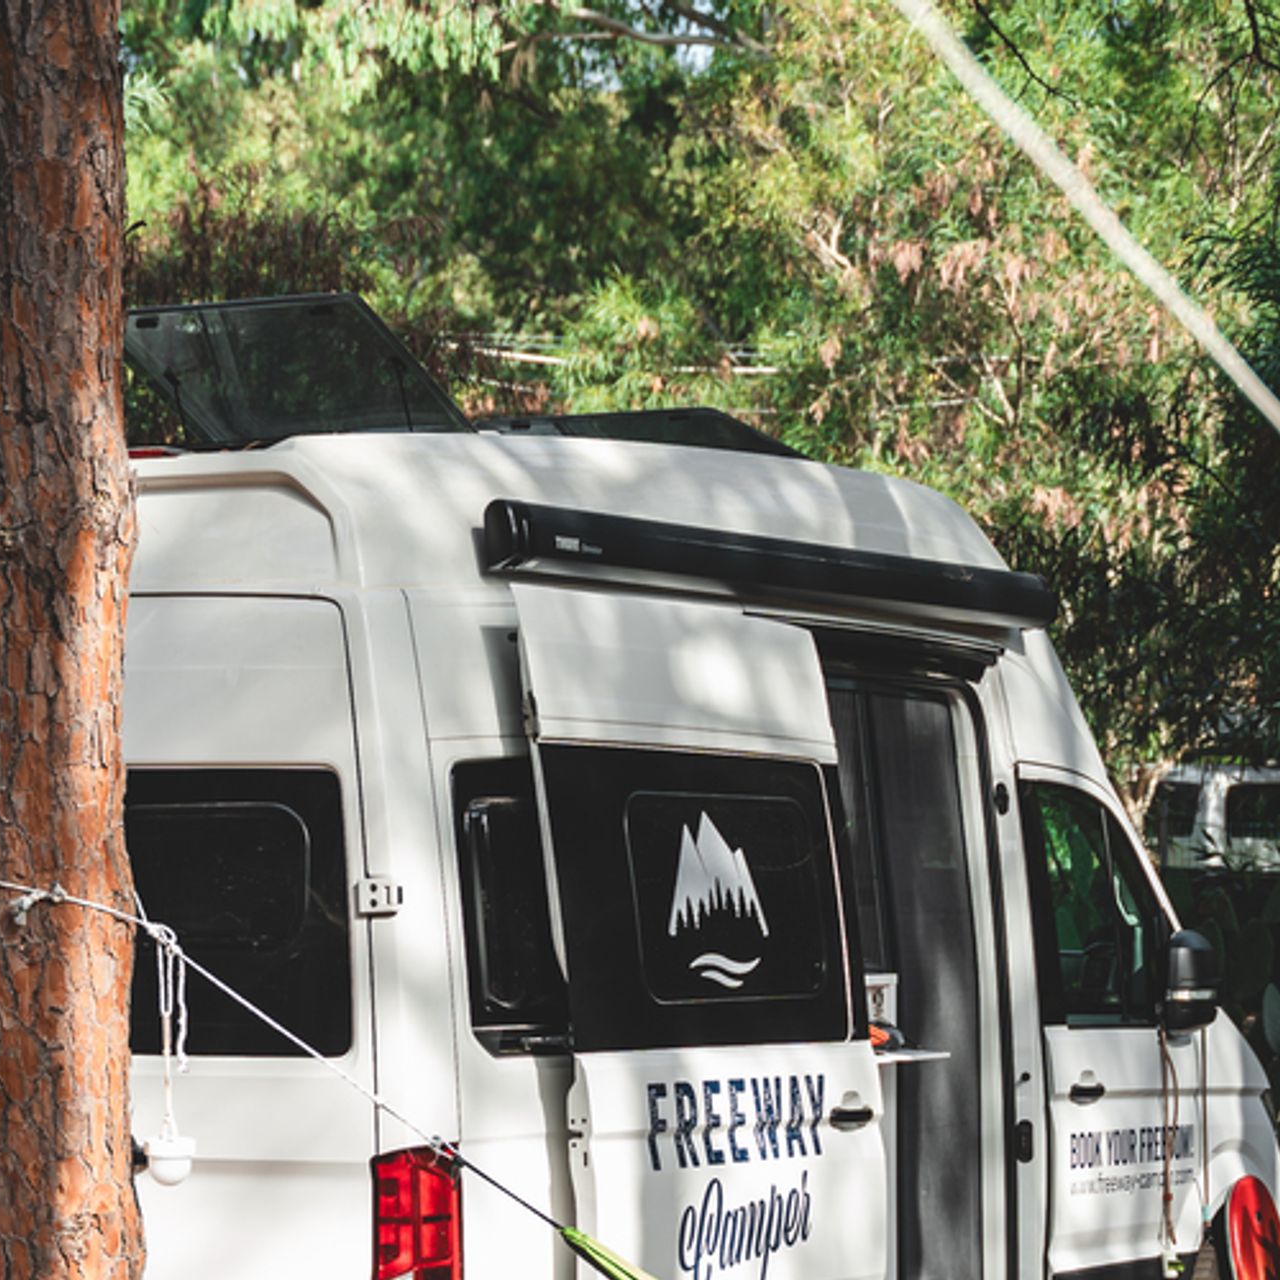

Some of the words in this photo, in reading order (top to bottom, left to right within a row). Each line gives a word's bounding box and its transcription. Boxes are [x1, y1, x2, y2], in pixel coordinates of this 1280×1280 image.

[647, 1074, 824, 1171] FREEWAY
[1070, 1131, 1102, 1169] BOOK
[1106, 1129, 1137, 1165] YOUR
